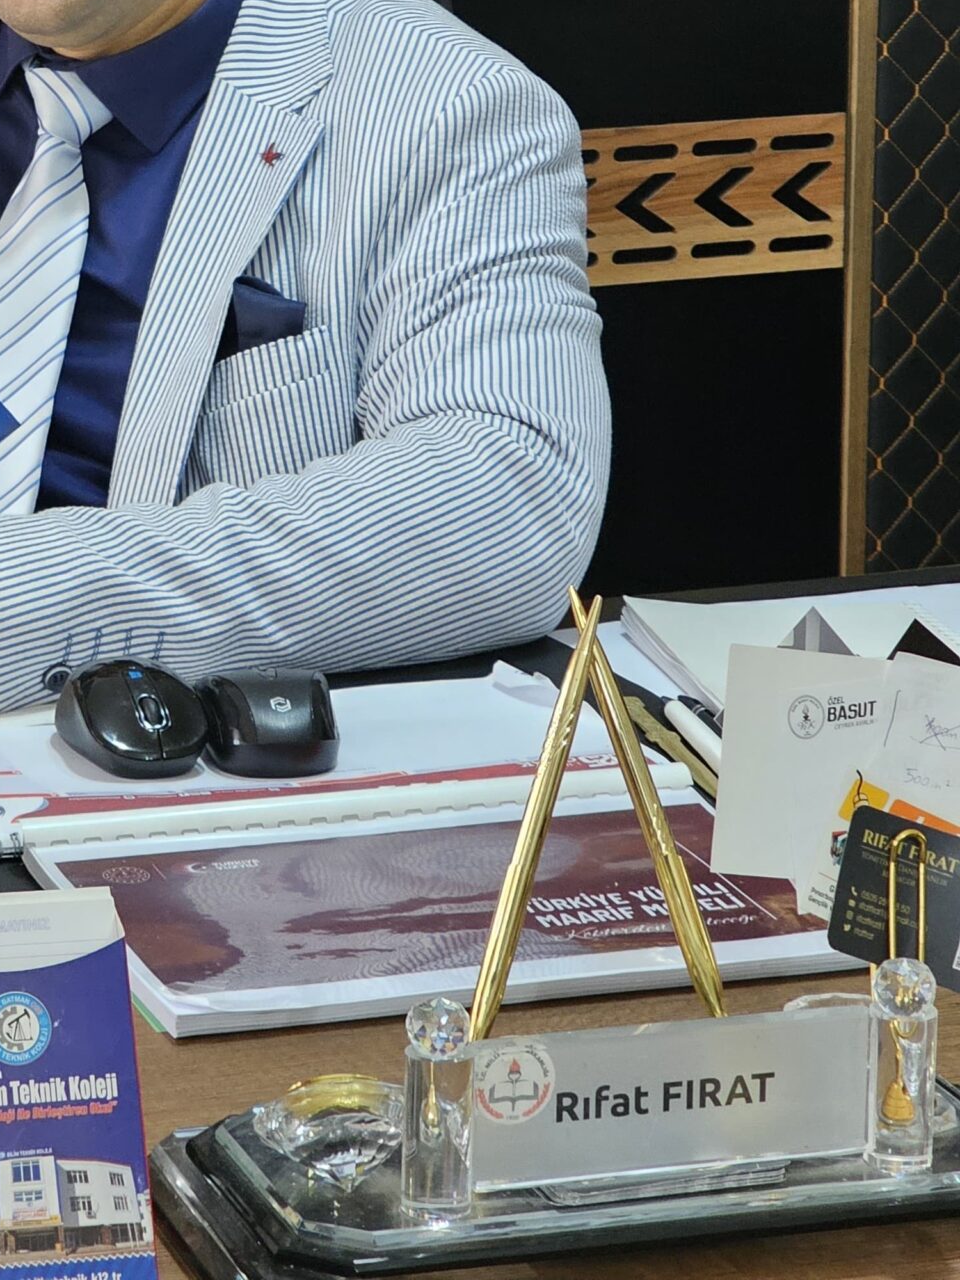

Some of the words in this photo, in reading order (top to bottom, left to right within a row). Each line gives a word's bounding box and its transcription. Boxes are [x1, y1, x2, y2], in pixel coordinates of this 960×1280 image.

[827, 700, 877, 723] BASUT
[908, 843, 960, 874] FRAT
[628, 881, 729, 902] YÜILI
[535, 905, 635, 928] MAARİF
[640, 893, 746, 917] MELİ
[9, 1077, 68, 1105] Teknik
[68, 1072, 119, 1102] Koleji
[555, 1086, 649, 1123] Rıfat
[661, 1071, 776, 1113] FIRAT
